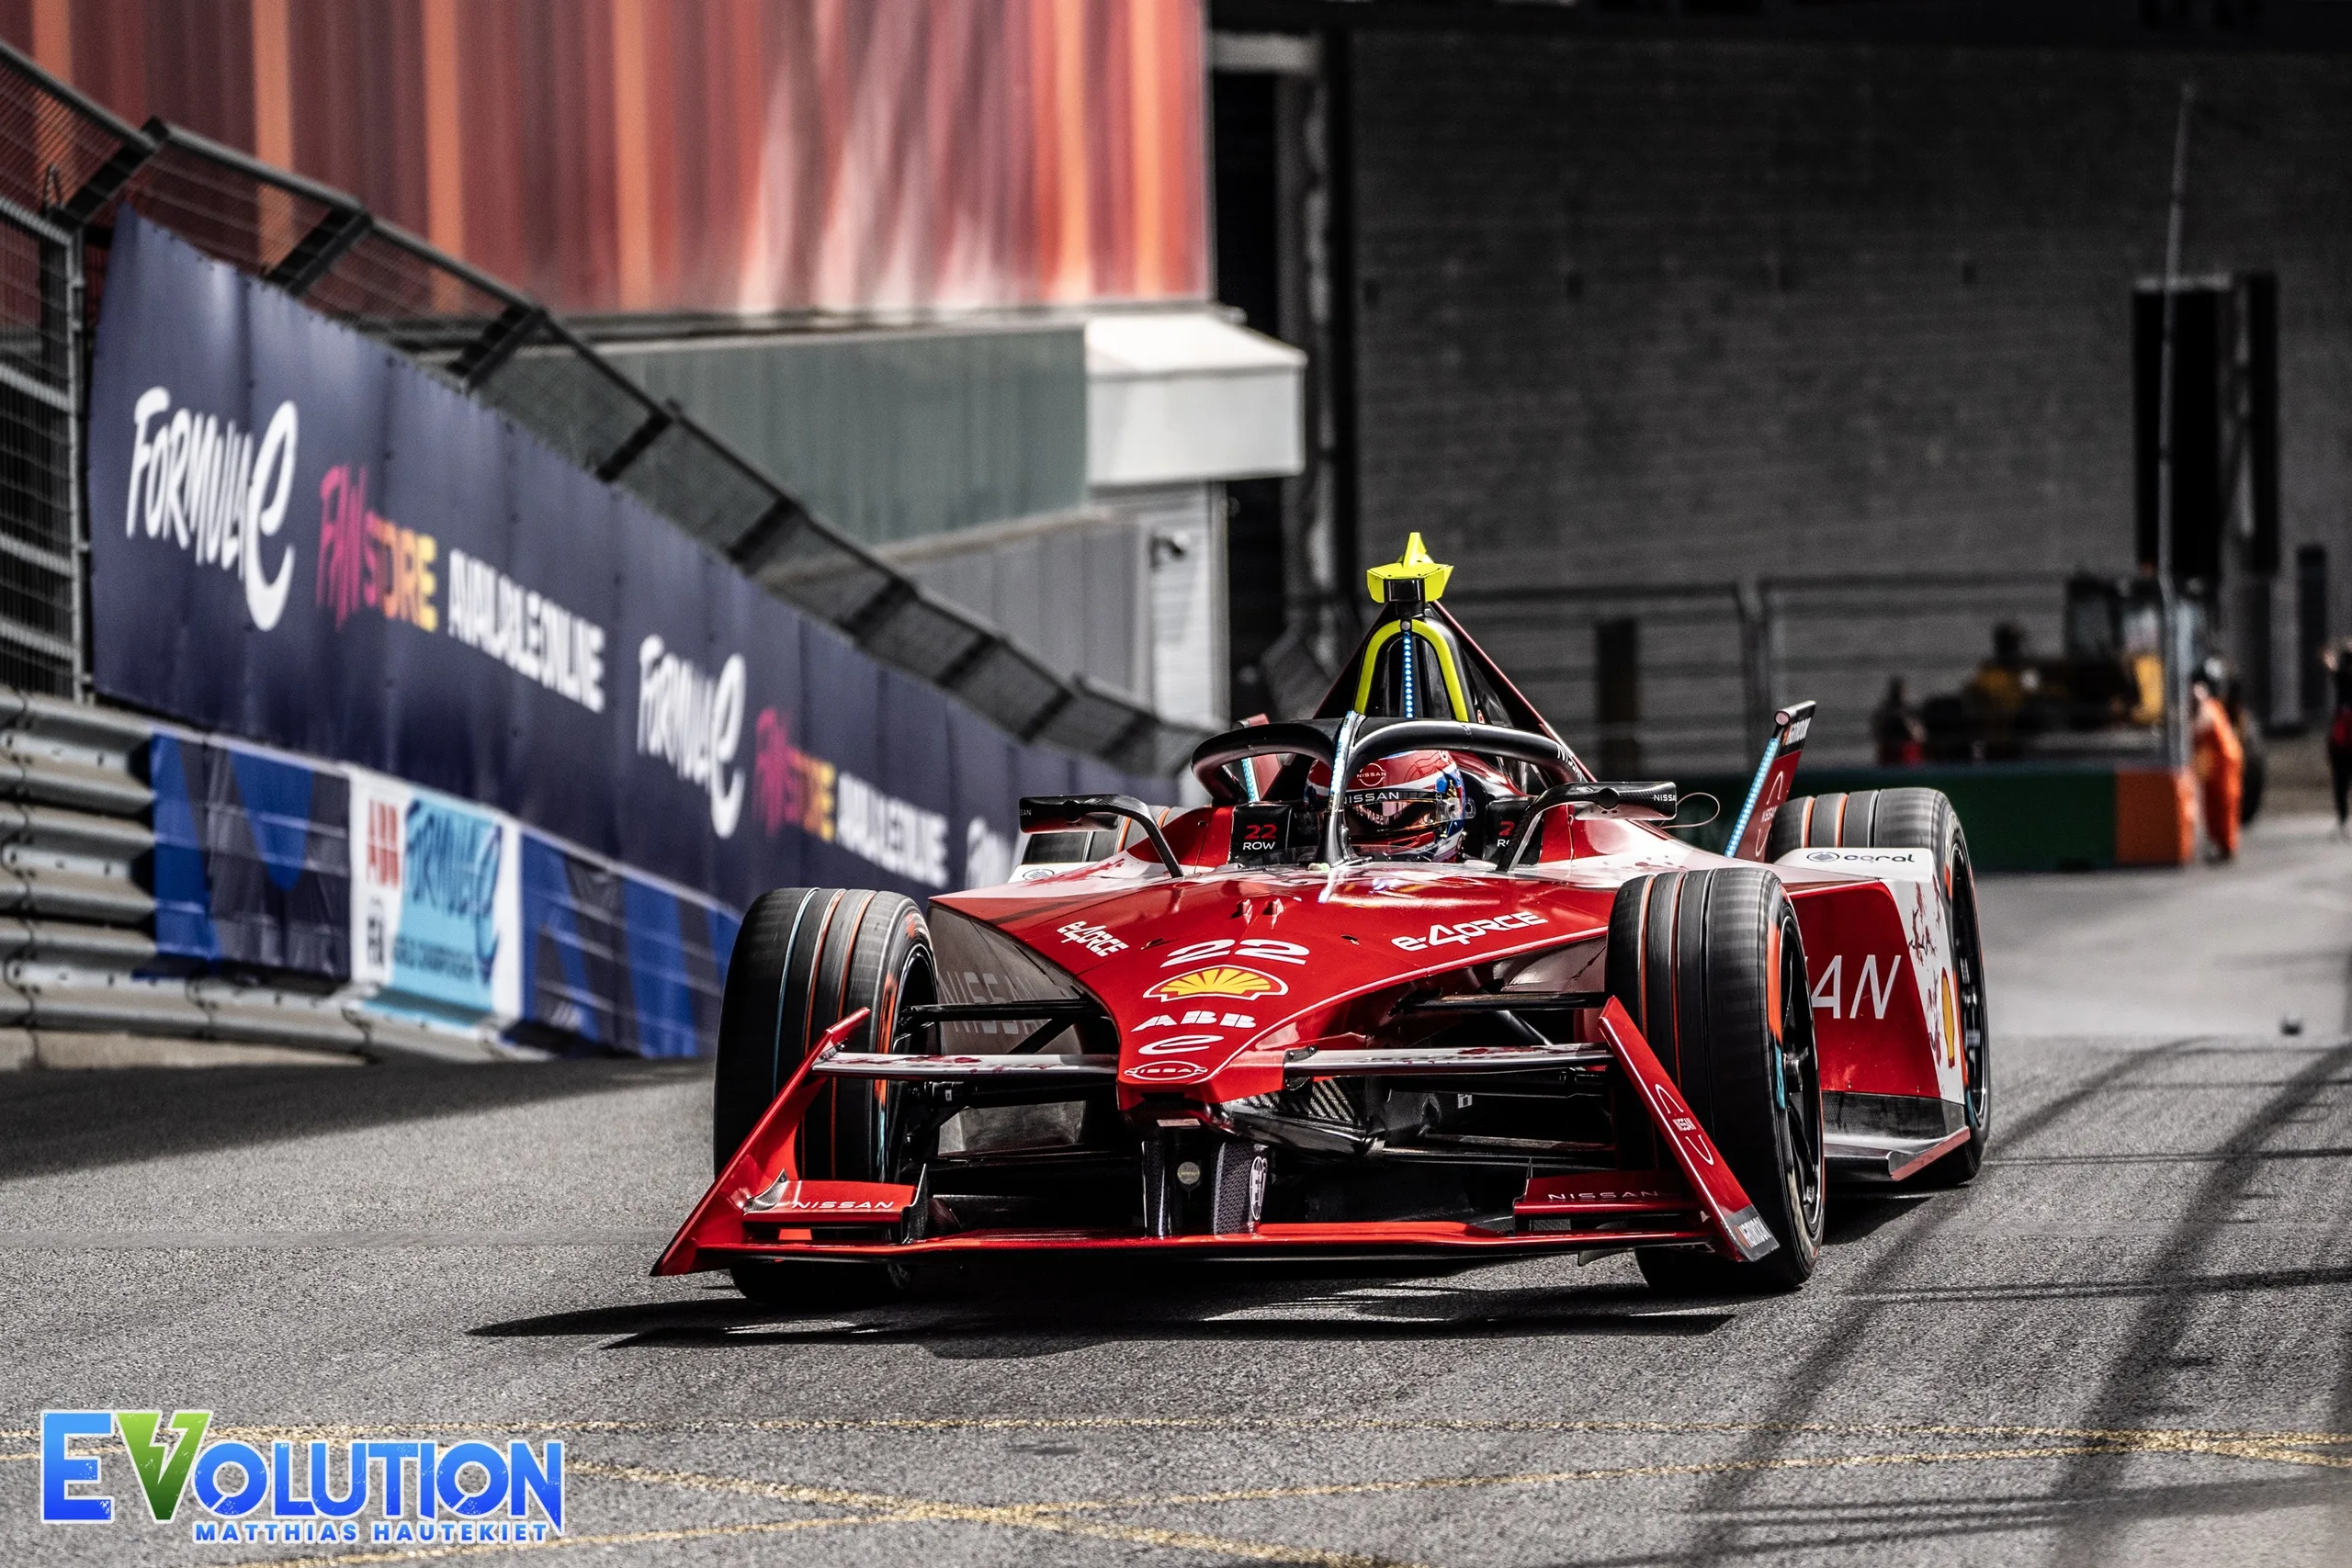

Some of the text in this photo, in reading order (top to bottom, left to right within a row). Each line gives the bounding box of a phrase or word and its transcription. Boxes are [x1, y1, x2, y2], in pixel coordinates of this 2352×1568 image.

[1243, 823, 1277, 840] 22
[1242, 841, 1276, 851] ROW
[1496, 839, 1510, 848] R
[1159, 939, 1311, 969] 22
[1130, 1010, 1257, 1032] ABB
[1124, 1066, 1209, 1076] NISSAN
[1548, 1190, 1659, 1201] NISSAN
[792, 1201, 895, 1210] NISSAN
